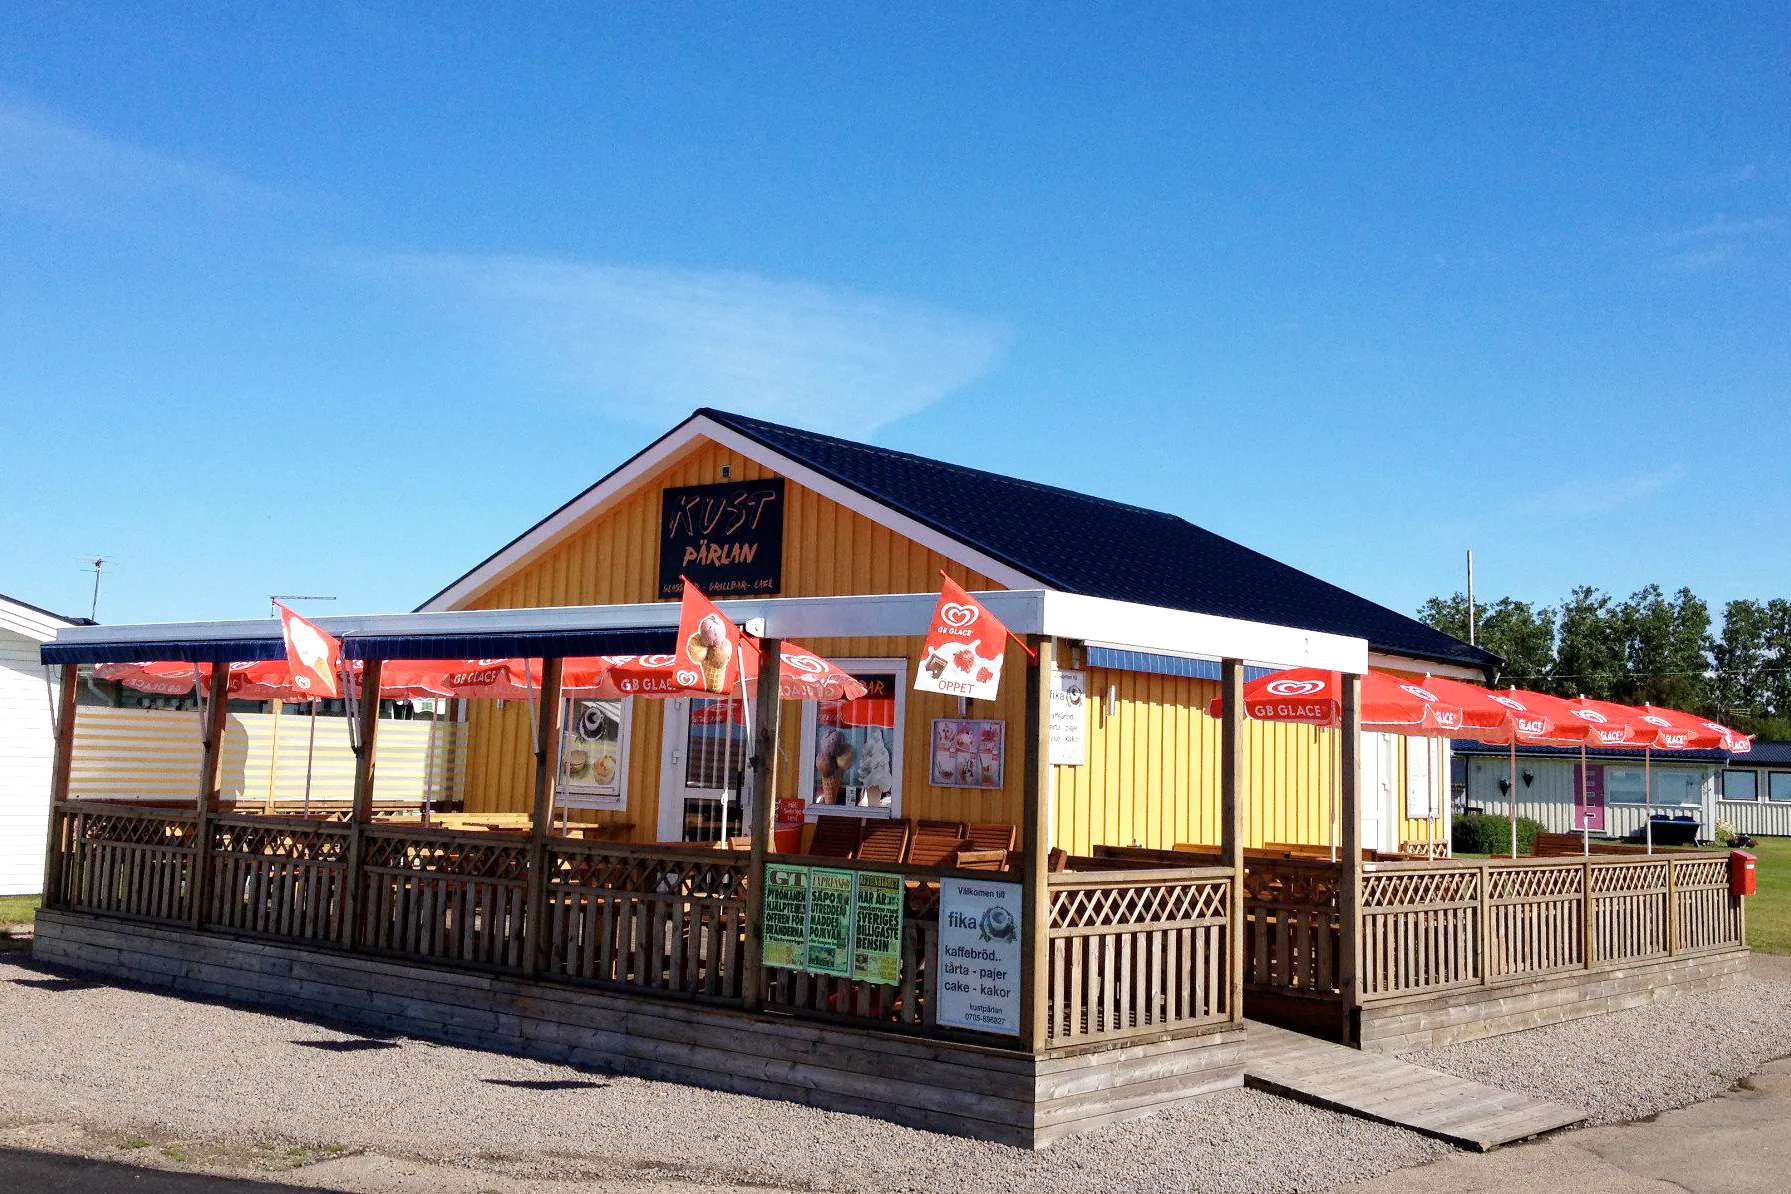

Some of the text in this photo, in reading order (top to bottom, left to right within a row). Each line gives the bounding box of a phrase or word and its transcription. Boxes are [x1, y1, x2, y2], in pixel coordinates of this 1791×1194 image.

[669, 489, 776, 538] KUST
[682, 539, 758, 567] PÄRLAN
[937, 626, 973, 637] GB GLACE
[619, 678, 676, 691] GB GLAC
[938, 677, 975, 694] ÖPPET
[1255, 703, 1321, 718] GB GLACE
[1518, 718, 1542, 733] GLACE
[770, 869, 808, 886] GT
[811, 890, 836, 905] SÄPO
[858, 891, 873, 904] HÄR
[766, 911, 804, 926] OFFREN FÖR
[857, 911, 899, 927] SVERIGES
[948, 911, 977, 930] fika
[857, 924, 898, 940] BILLIGASTE
[856, 937, 889, 953] BENSIN
[945, 945, 1001, 962] kaffebröd..
[944, 962, 969, 976] tårta
[979, 967, 1007, 981] pajer
[944, 980, 970, 993] cake
[980, 984, 1011, 998] kakor
